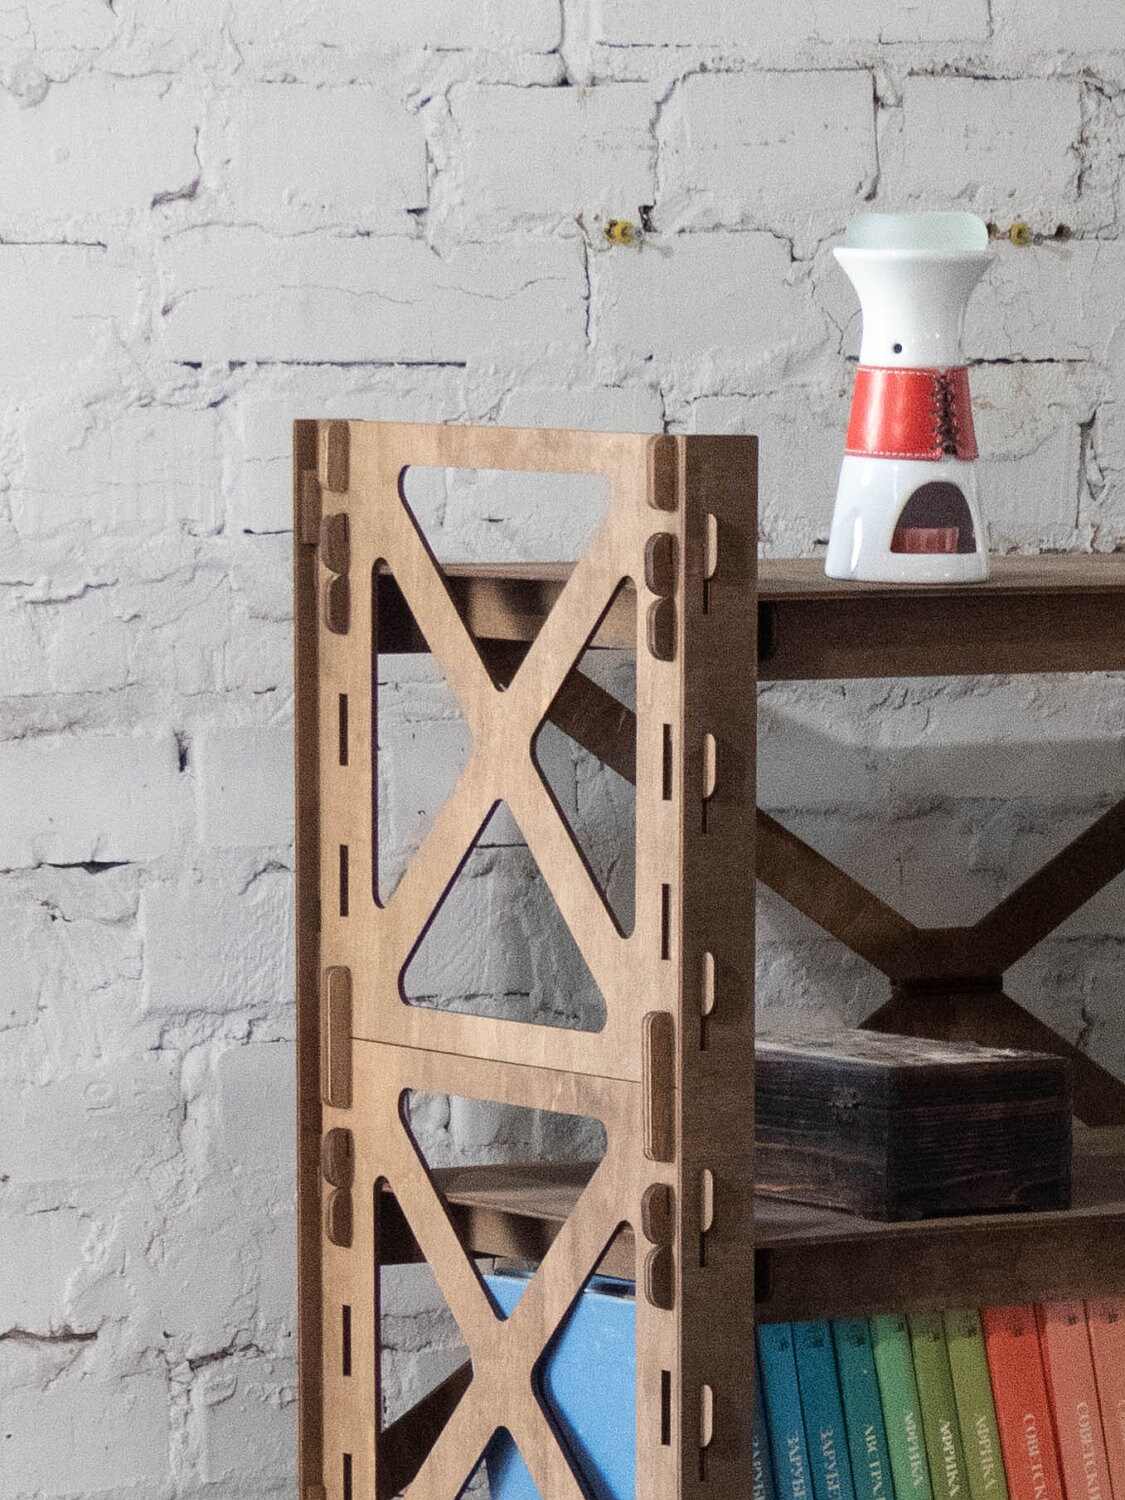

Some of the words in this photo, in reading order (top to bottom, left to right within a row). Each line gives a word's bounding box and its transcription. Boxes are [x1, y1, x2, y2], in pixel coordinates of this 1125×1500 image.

[902, 1409, 924, 1489] АФРИКА
[938, 1417, 961, 1499] АФРИКА
[974, 1412, 998, 1492] АФРИКА
